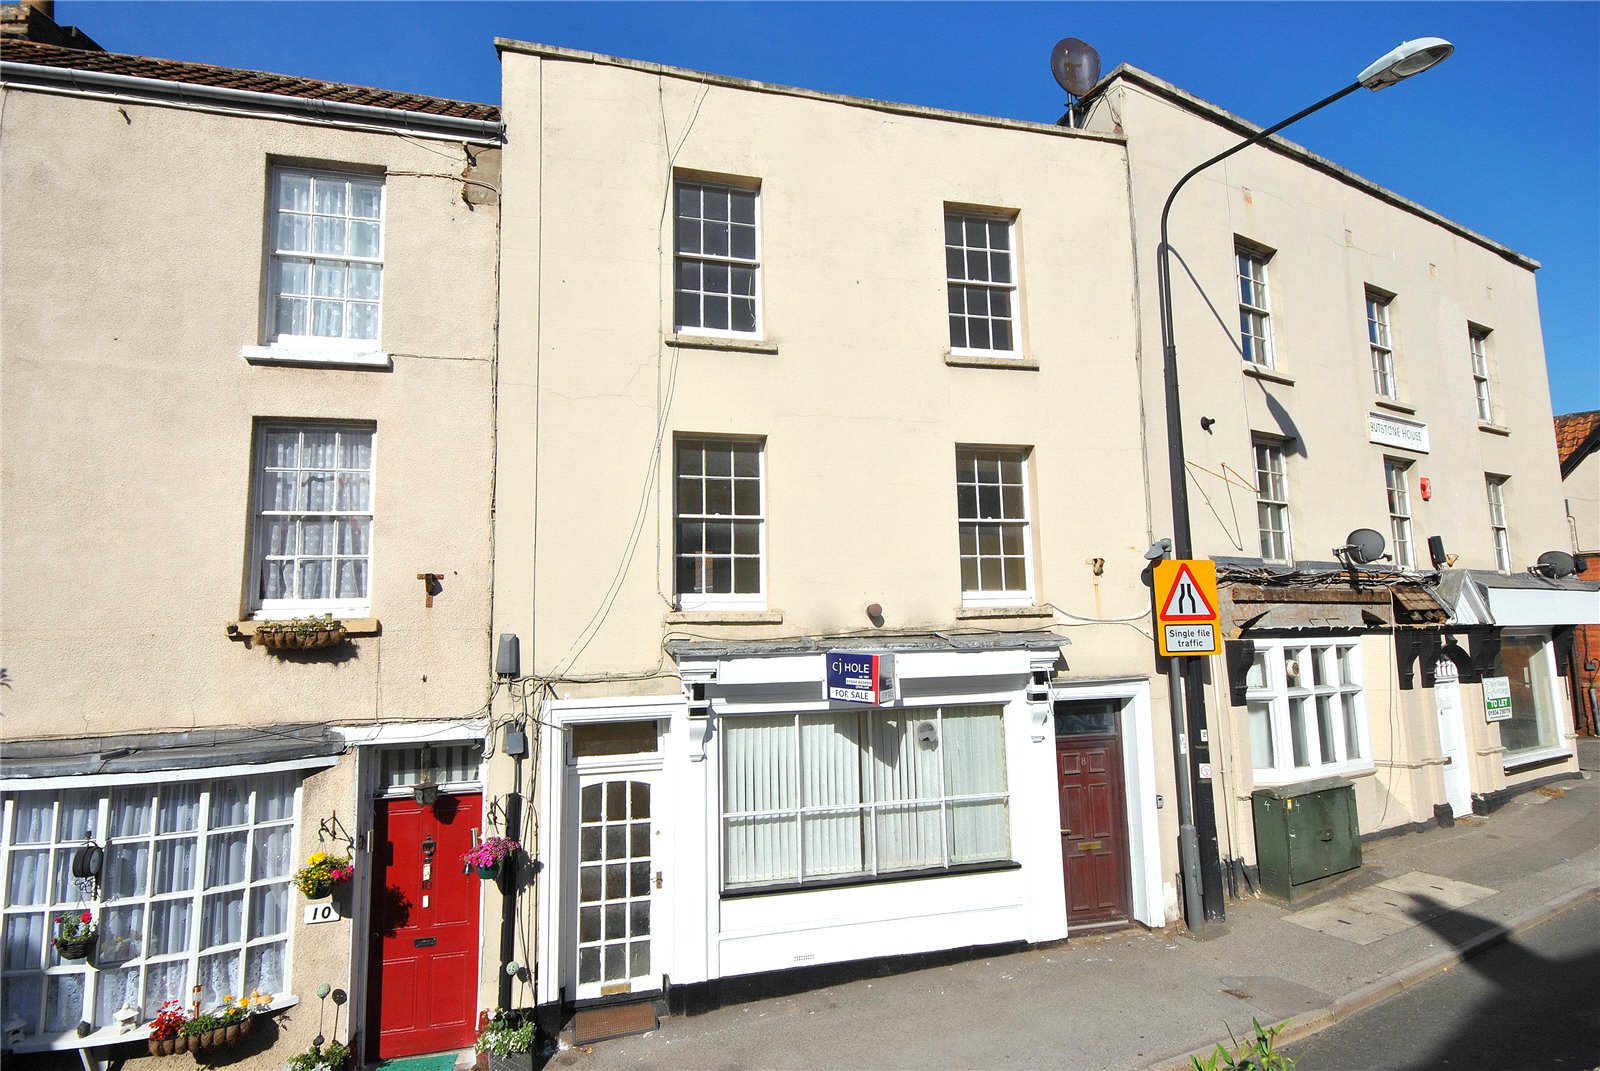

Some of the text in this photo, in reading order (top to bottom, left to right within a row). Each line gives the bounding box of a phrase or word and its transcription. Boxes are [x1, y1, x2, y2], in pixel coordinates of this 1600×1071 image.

[1401, 428, 1422, 442] HOUSE
[1169, 629, 1211, 639] Single file
[1178, 639, 1203, 647] traffic
[844, 662, 870, 674] HOLE
[835, 689, 869, 700] FOR SALE
[1491, 699, 1508, 708] TO LET
[1081, 757, 1087, 766] 8
[312, 906, 332, 920] 10
